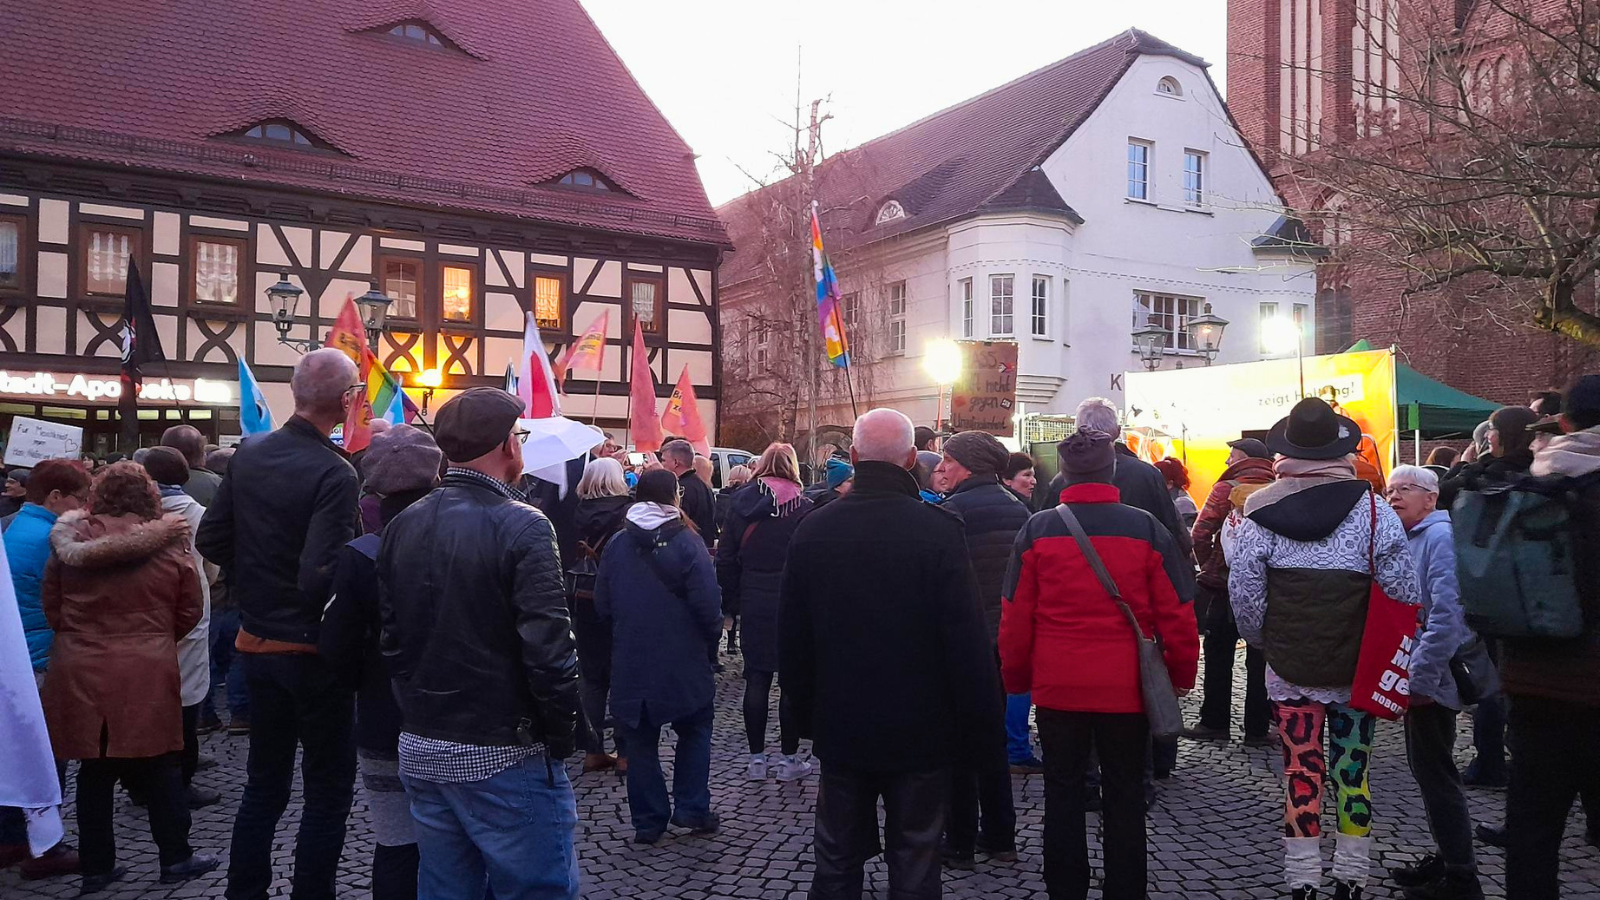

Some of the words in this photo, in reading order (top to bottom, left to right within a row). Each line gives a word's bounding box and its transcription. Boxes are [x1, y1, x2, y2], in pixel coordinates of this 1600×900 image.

[1110, 373, 1122, 391] K
[969, 396, 998, 412] gegen
[1258, 393, 1290, 406] zeigt
